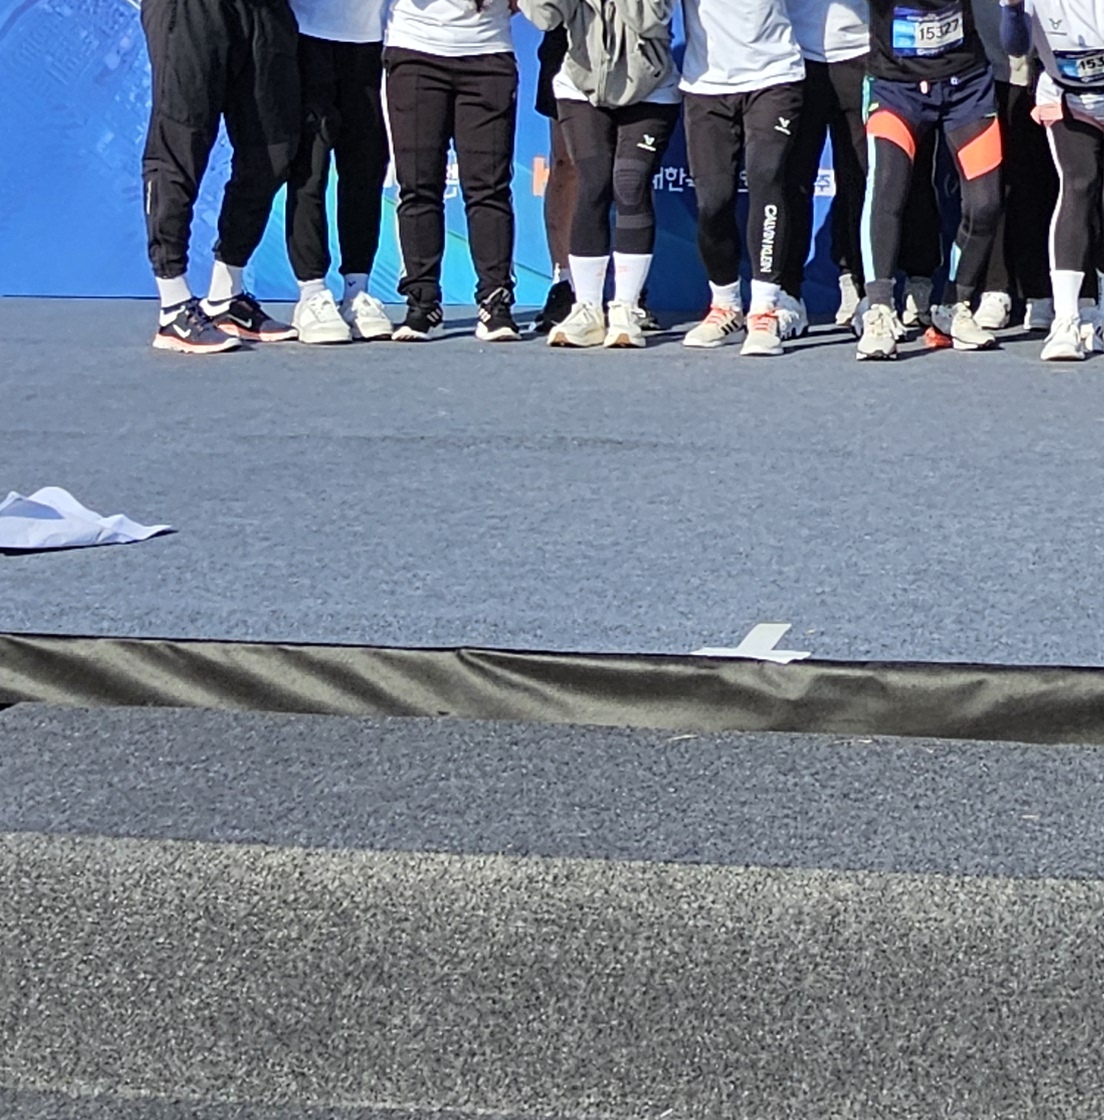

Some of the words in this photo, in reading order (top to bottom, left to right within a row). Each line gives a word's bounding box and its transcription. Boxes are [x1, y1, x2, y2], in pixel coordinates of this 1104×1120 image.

[918, 19, 959, 41] 15327
[762, 204, 778, 244] CALVIN
[759, 244, 774, 273] KLEIN
